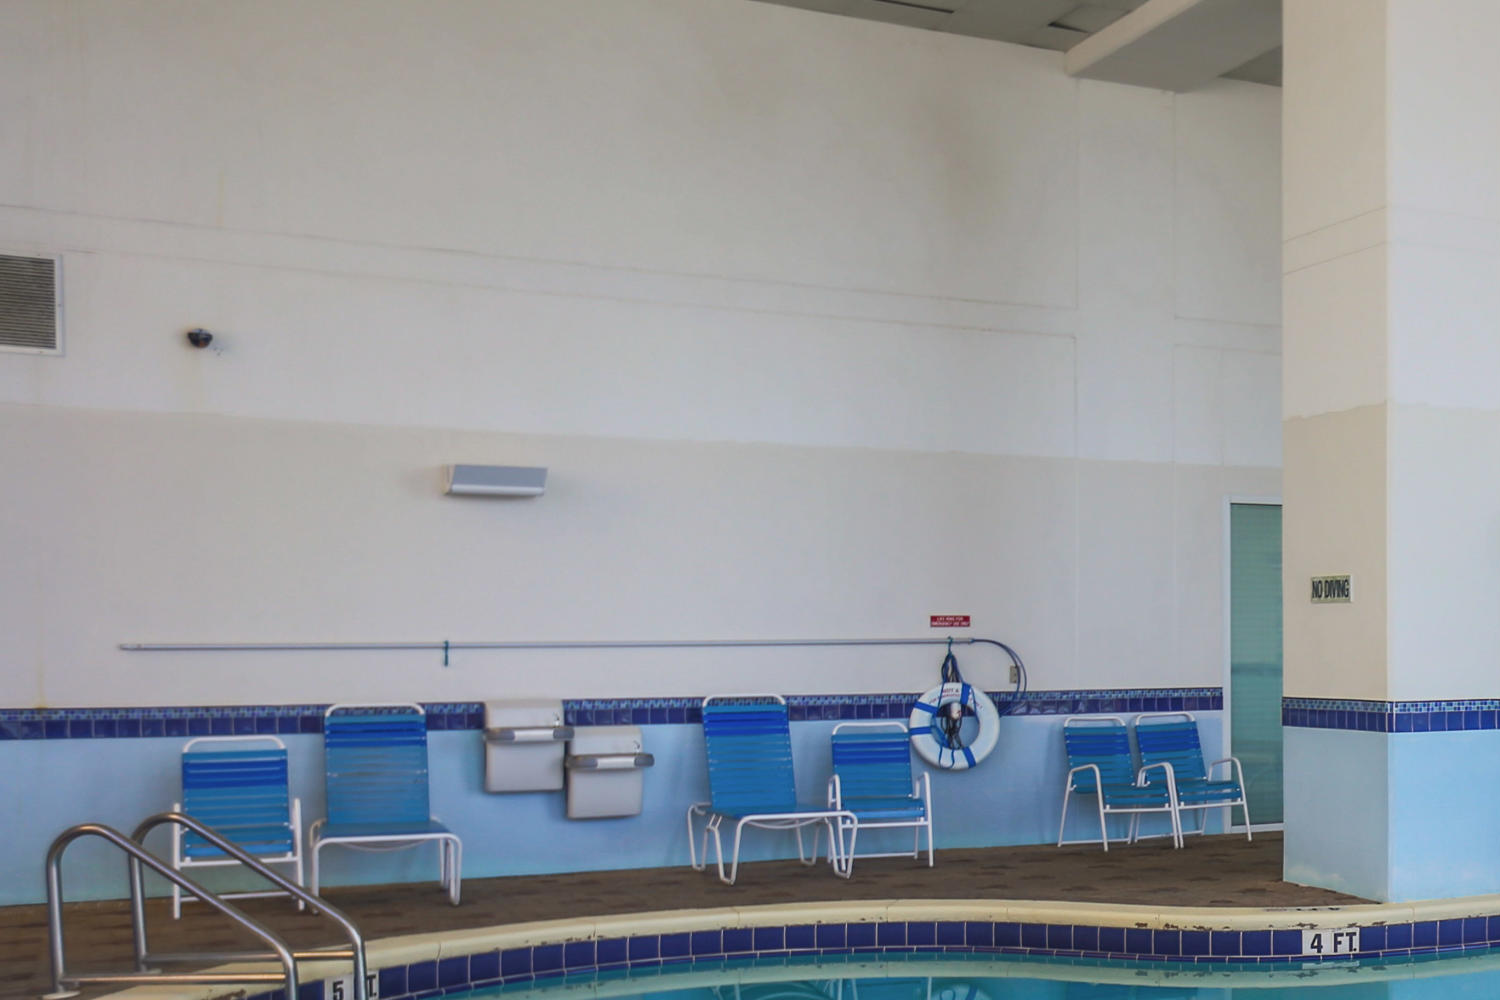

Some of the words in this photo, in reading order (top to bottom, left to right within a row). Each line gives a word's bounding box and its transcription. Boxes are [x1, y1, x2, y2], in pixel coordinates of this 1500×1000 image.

[1312, 580, 1322, 598] NO
[1325, 579, 1349, 598] DIVING
[1310, 933, 1323, 953] 4
[1333, 931, 1357, 953] FT.
